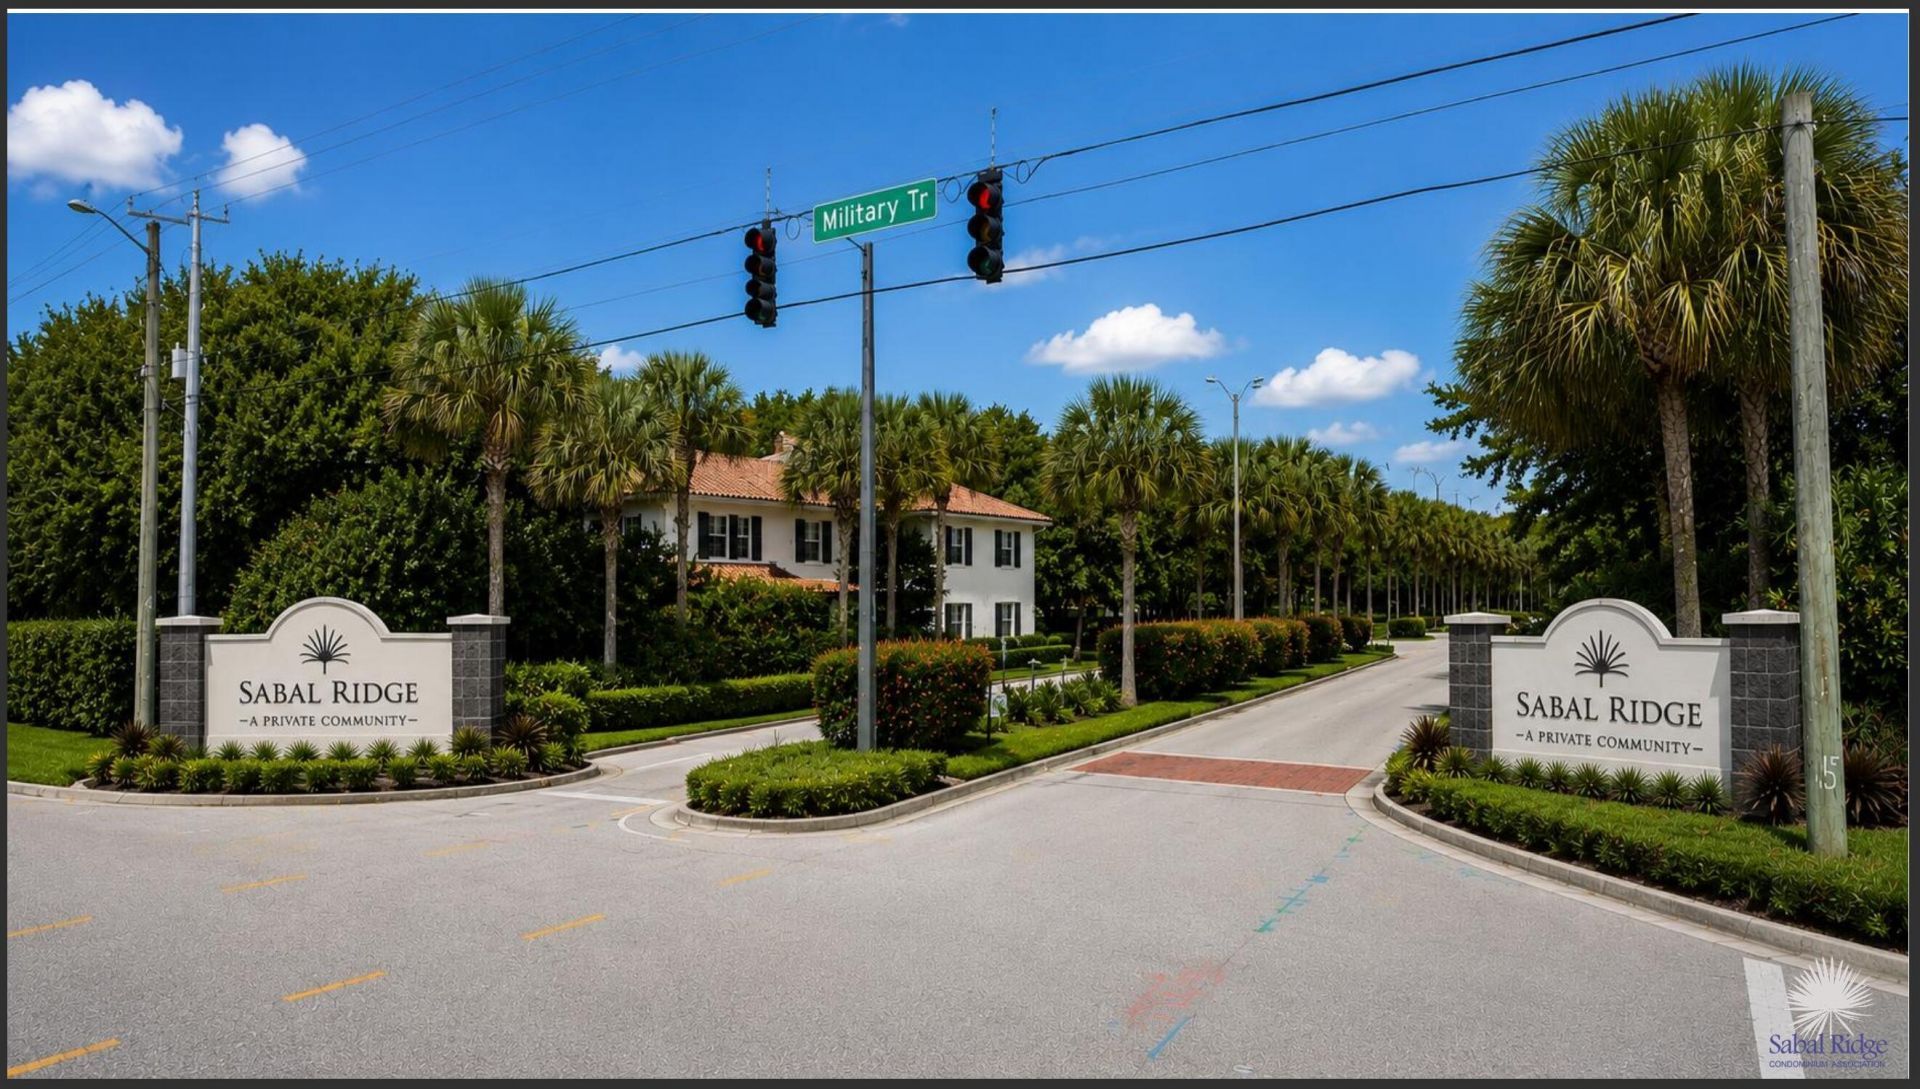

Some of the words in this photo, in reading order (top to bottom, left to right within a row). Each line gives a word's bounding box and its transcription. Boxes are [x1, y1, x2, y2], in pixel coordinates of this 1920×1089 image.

[823, 200, 898, 232] Military
[907, 189, 928, 212] Tr
[239, 680, 322, 704] SABAL
[332, 680, 419, 704] RIDGE
[263, 716, 315, 726] PRIVATE
[1516, 691, 1599, 721] SABAL
[1609, 696, 1703, 727] RIDGE
[1538, 731, 1592, 747] PRIVATE
